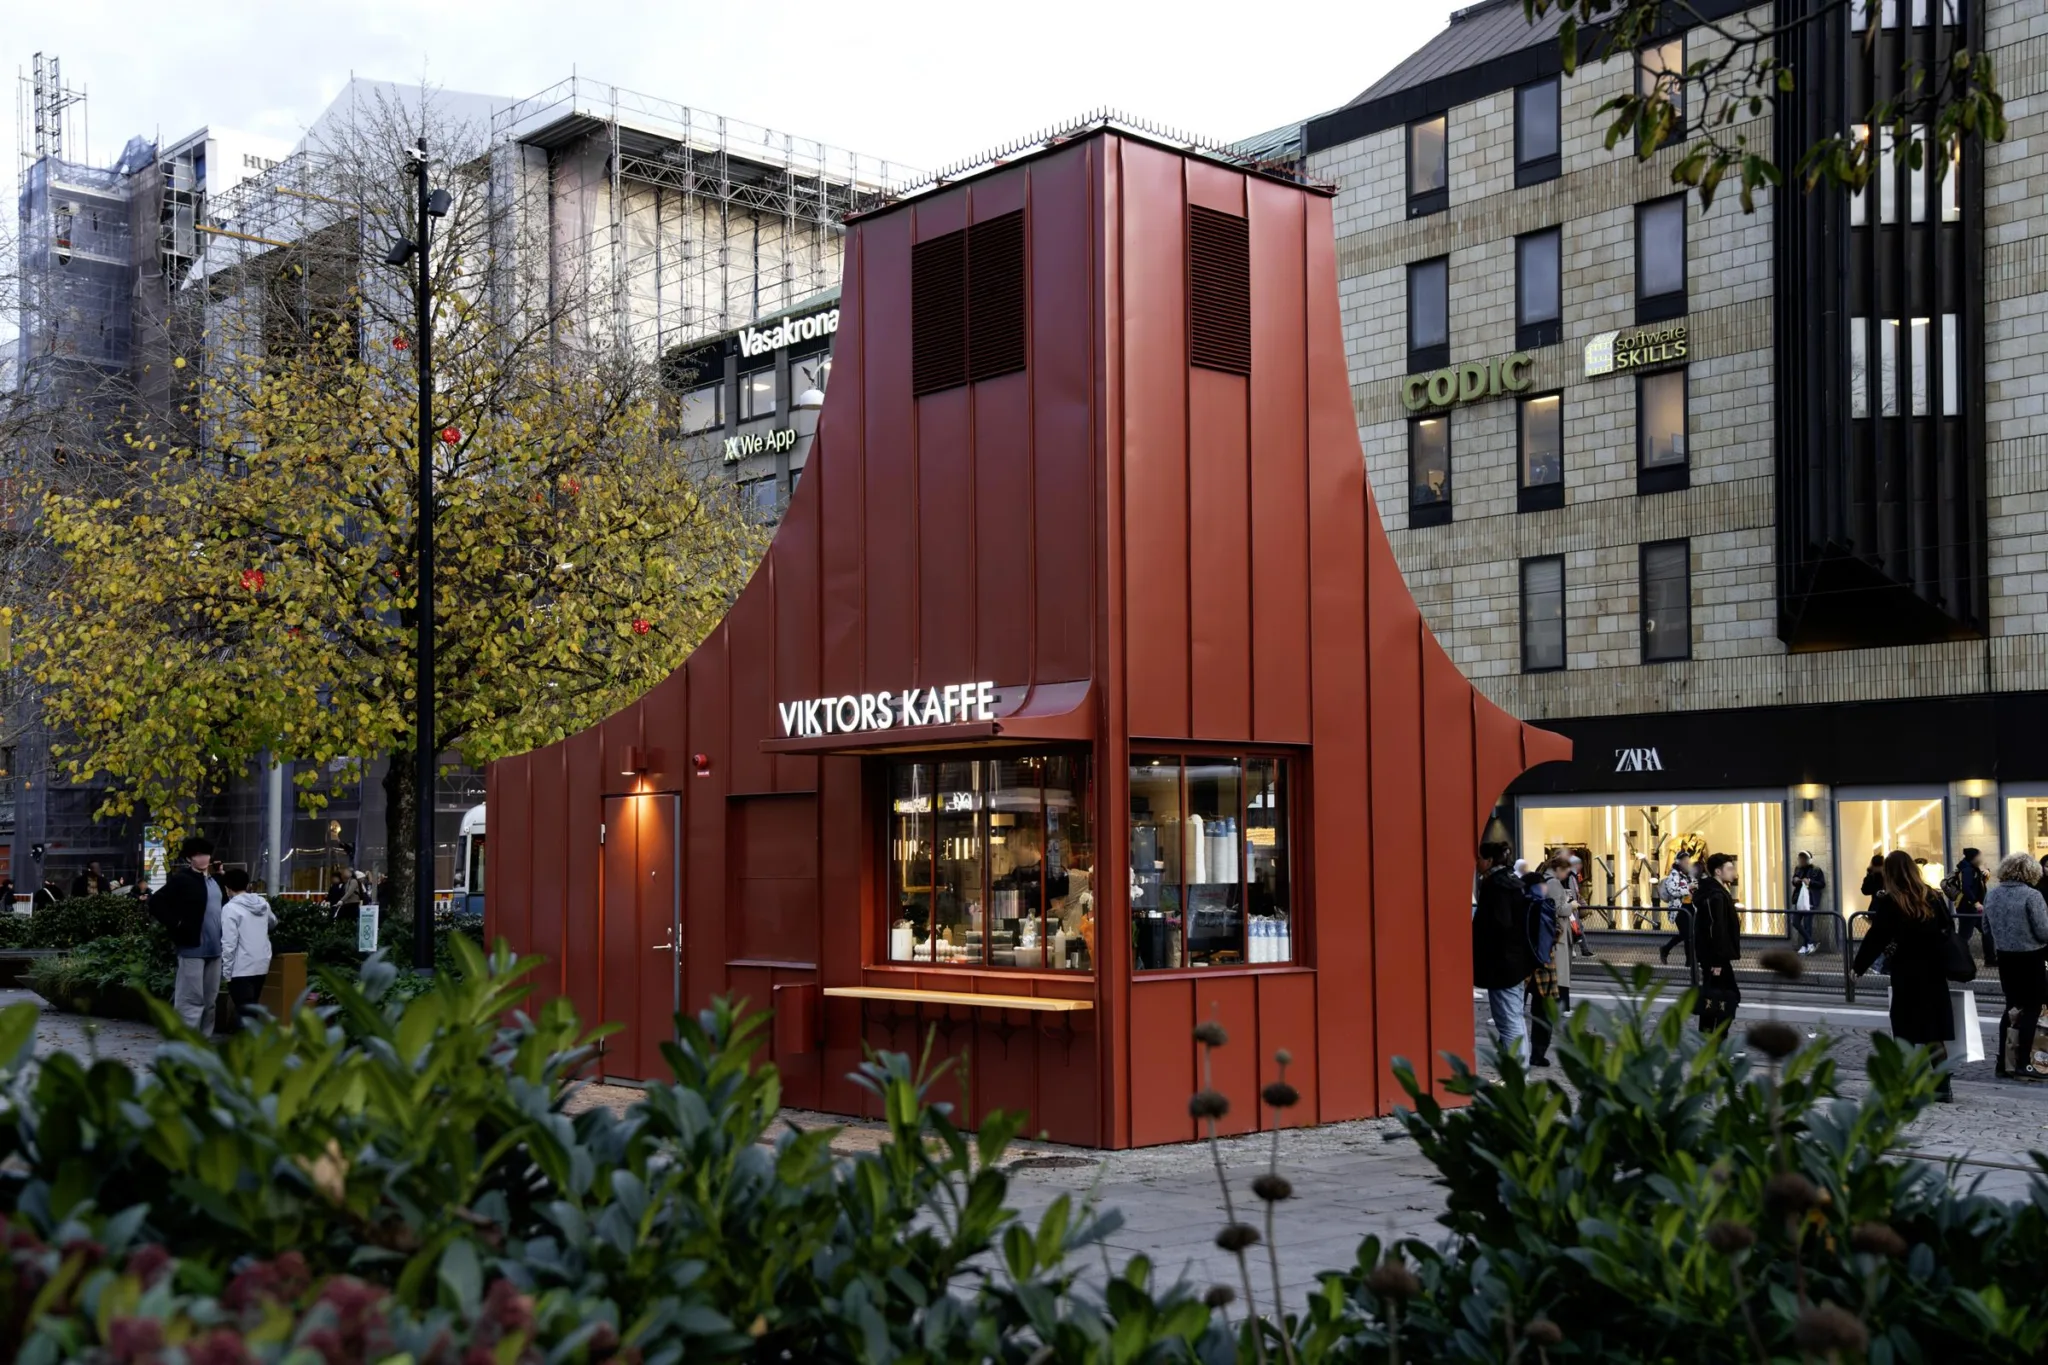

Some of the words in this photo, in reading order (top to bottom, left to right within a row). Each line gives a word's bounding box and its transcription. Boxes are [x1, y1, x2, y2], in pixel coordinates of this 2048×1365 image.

[1616, 326, 1686, 351] software
[1616, 340, 1687, 369] SKILLS
[1402, 351, 1533, 411] CODIC
[740, 433, 763, 456] We
[766, 429, 796, 453] App
[778, 690, 894, 737] VIKTORS
[902, 681, 994, 727] KAFFE
[1614, 746, 1664, 773] ZARA
